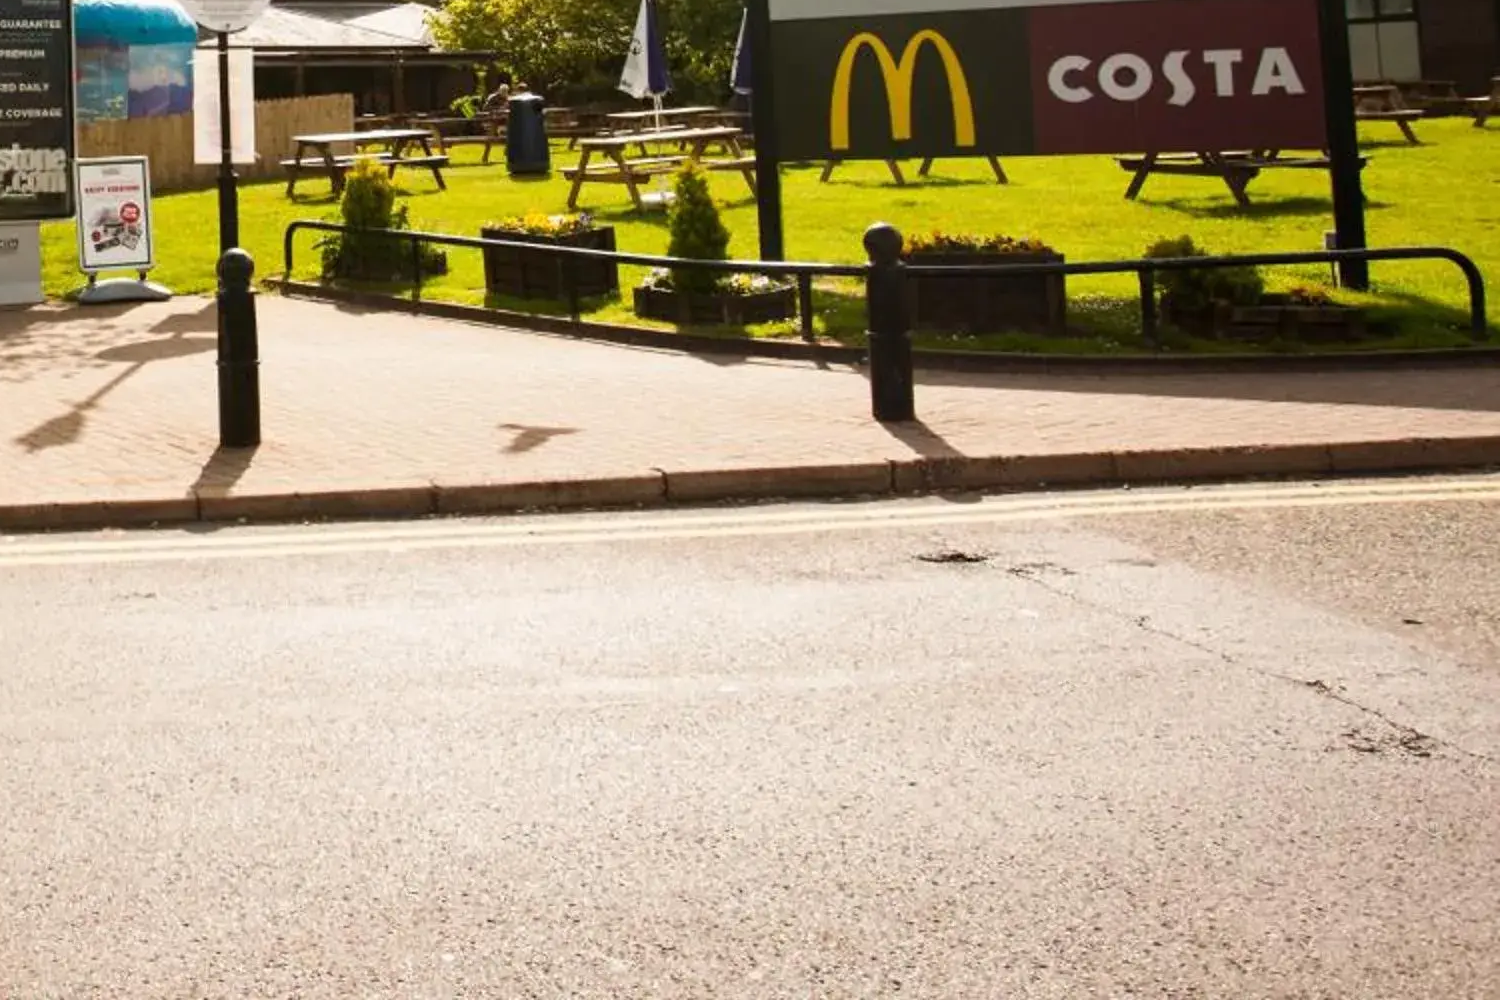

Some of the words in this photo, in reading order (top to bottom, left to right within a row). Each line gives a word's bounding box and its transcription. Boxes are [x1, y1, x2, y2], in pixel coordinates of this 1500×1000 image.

[0, 19, 62, 29] GUARANTEE
[0, 49, 45, 59] PREMIUM
[1046, 46, 1306, 108] COSTA
[19, 83, 49, 92] DAILY
[5, 107, 63, 118] COVERAGE
[5, 170, 67, 193] .com
